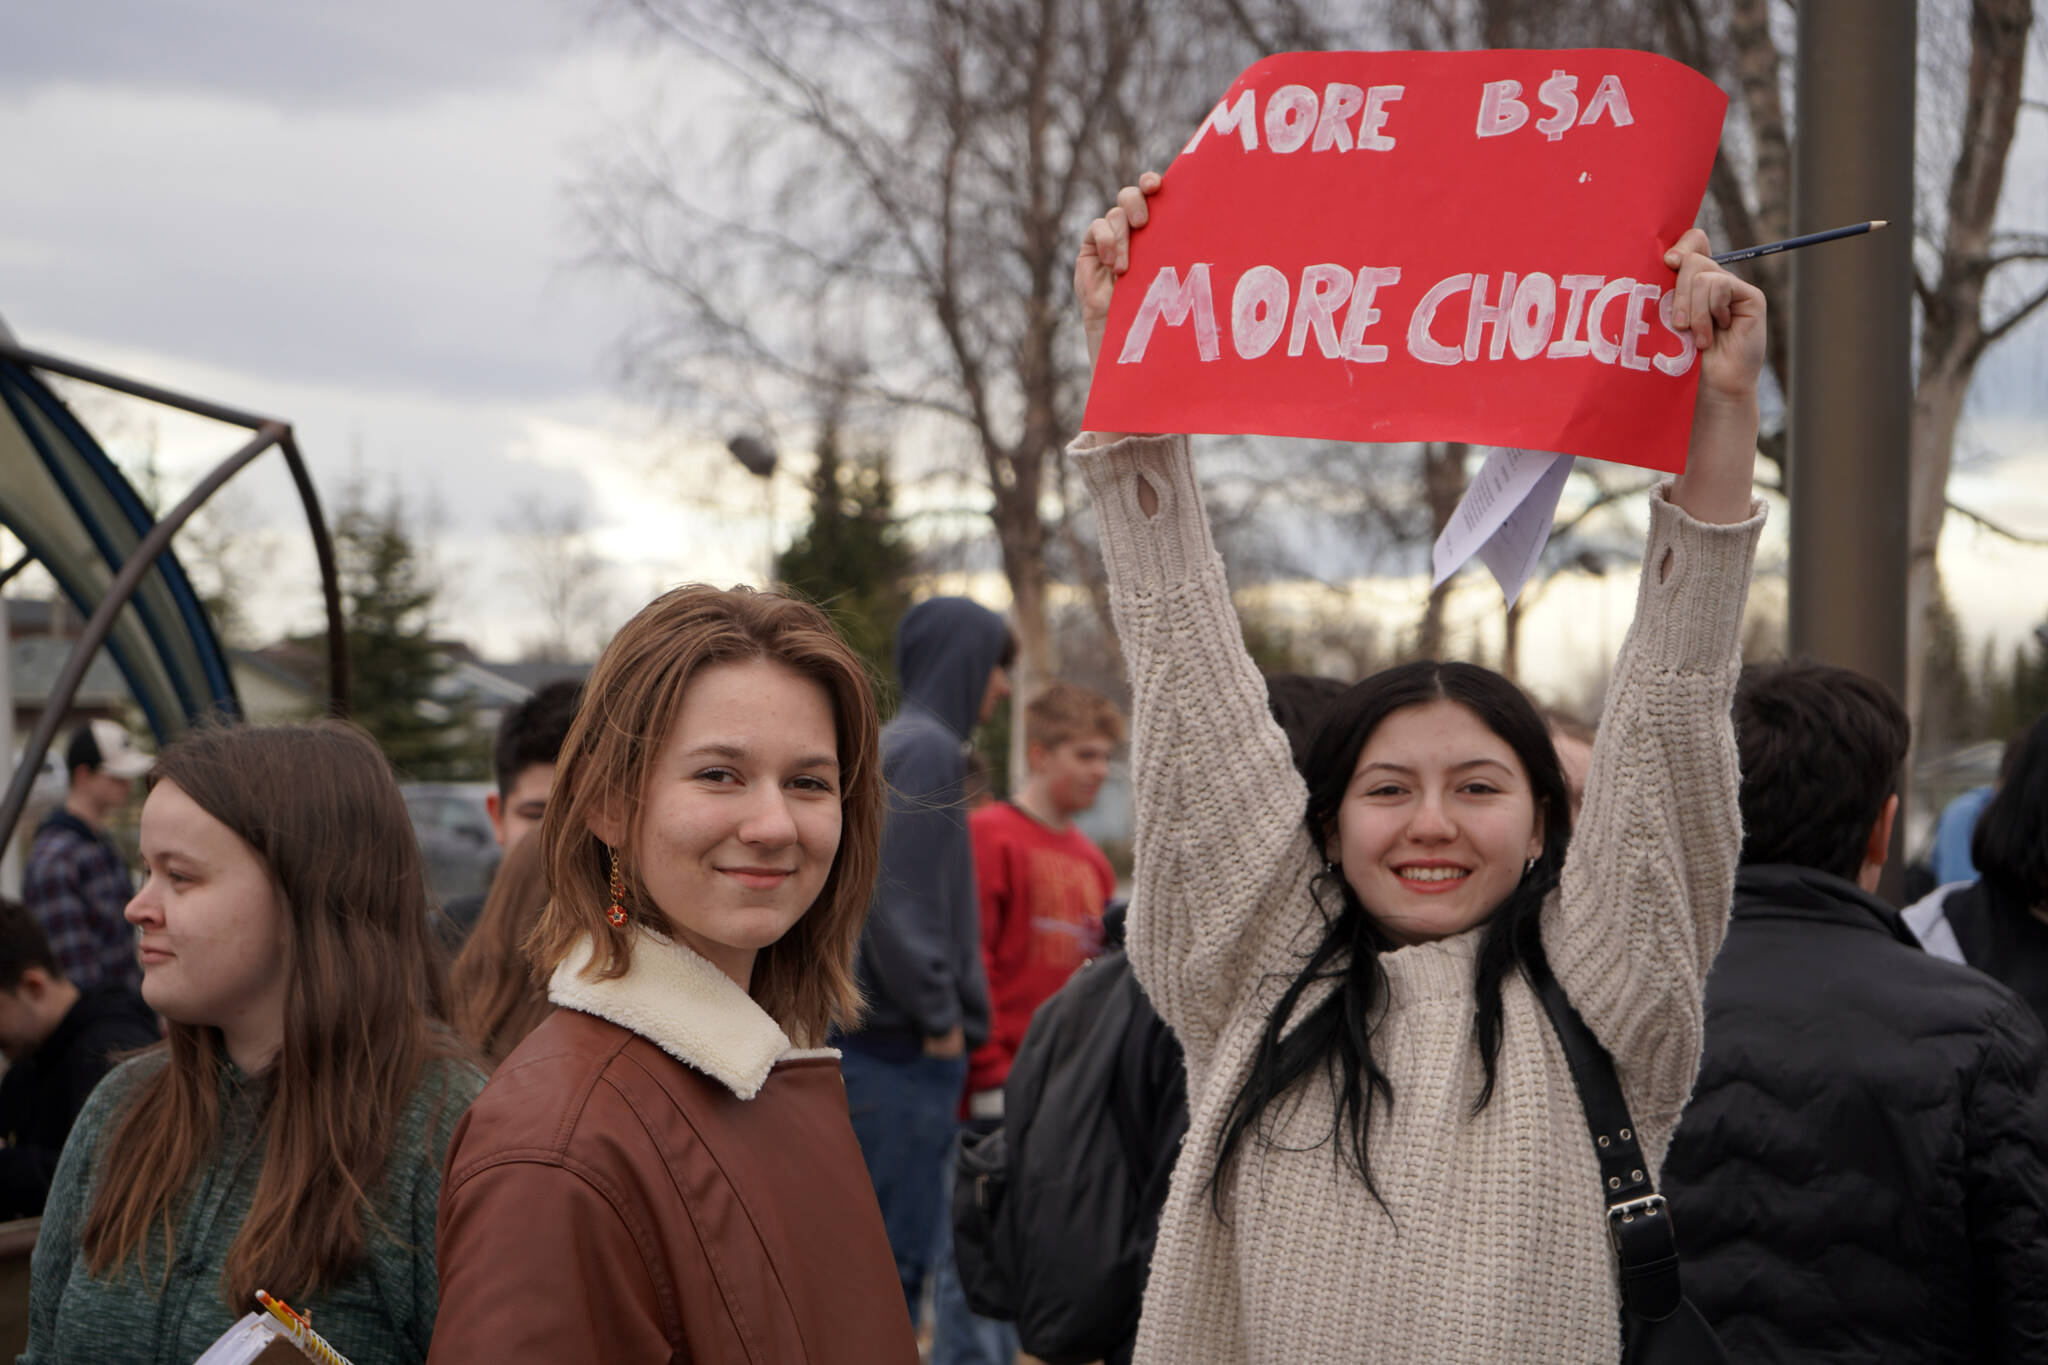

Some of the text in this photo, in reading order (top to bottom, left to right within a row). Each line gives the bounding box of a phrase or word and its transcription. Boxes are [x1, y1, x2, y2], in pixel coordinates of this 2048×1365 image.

[1182, 69, 1634, 154] MORE B$A
[1118, 263, 1697, 376] MORE CHOICES
